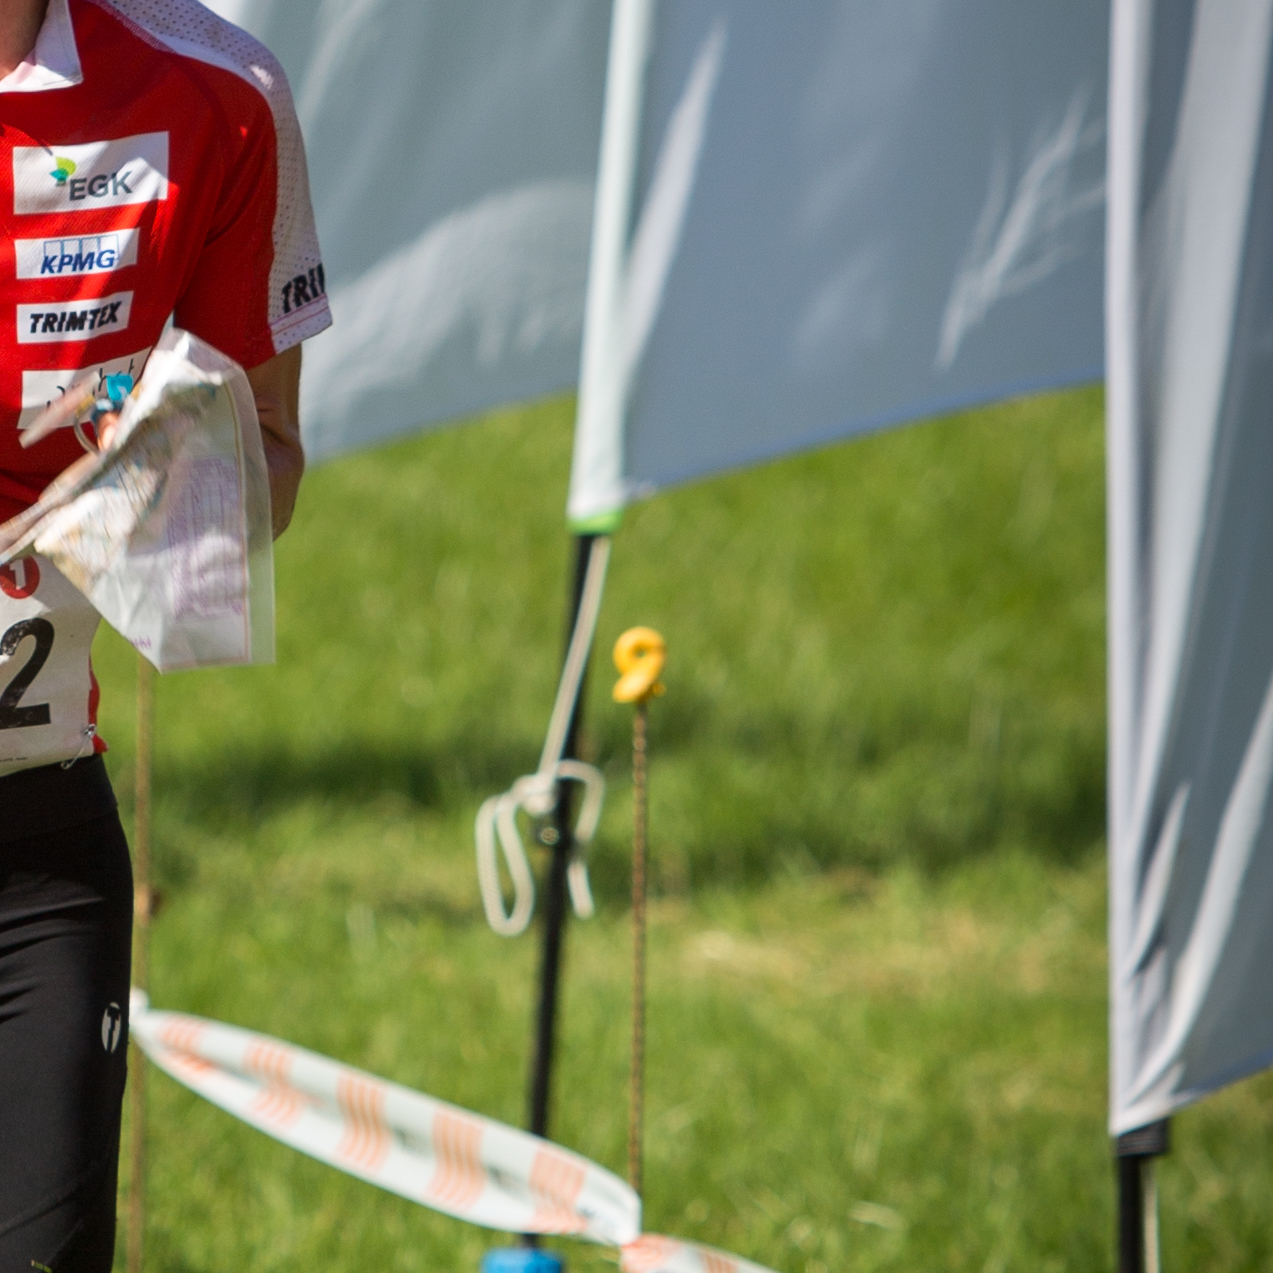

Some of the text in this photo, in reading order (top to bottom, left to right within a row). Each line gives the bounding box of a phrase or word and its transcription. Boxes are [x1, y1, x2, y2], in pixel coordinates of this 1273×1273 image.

[69, 171, 133, 202] EGK
[40, 249, 116, 274] KPMG
[30, 301, 122, 334] TRIMTEX
